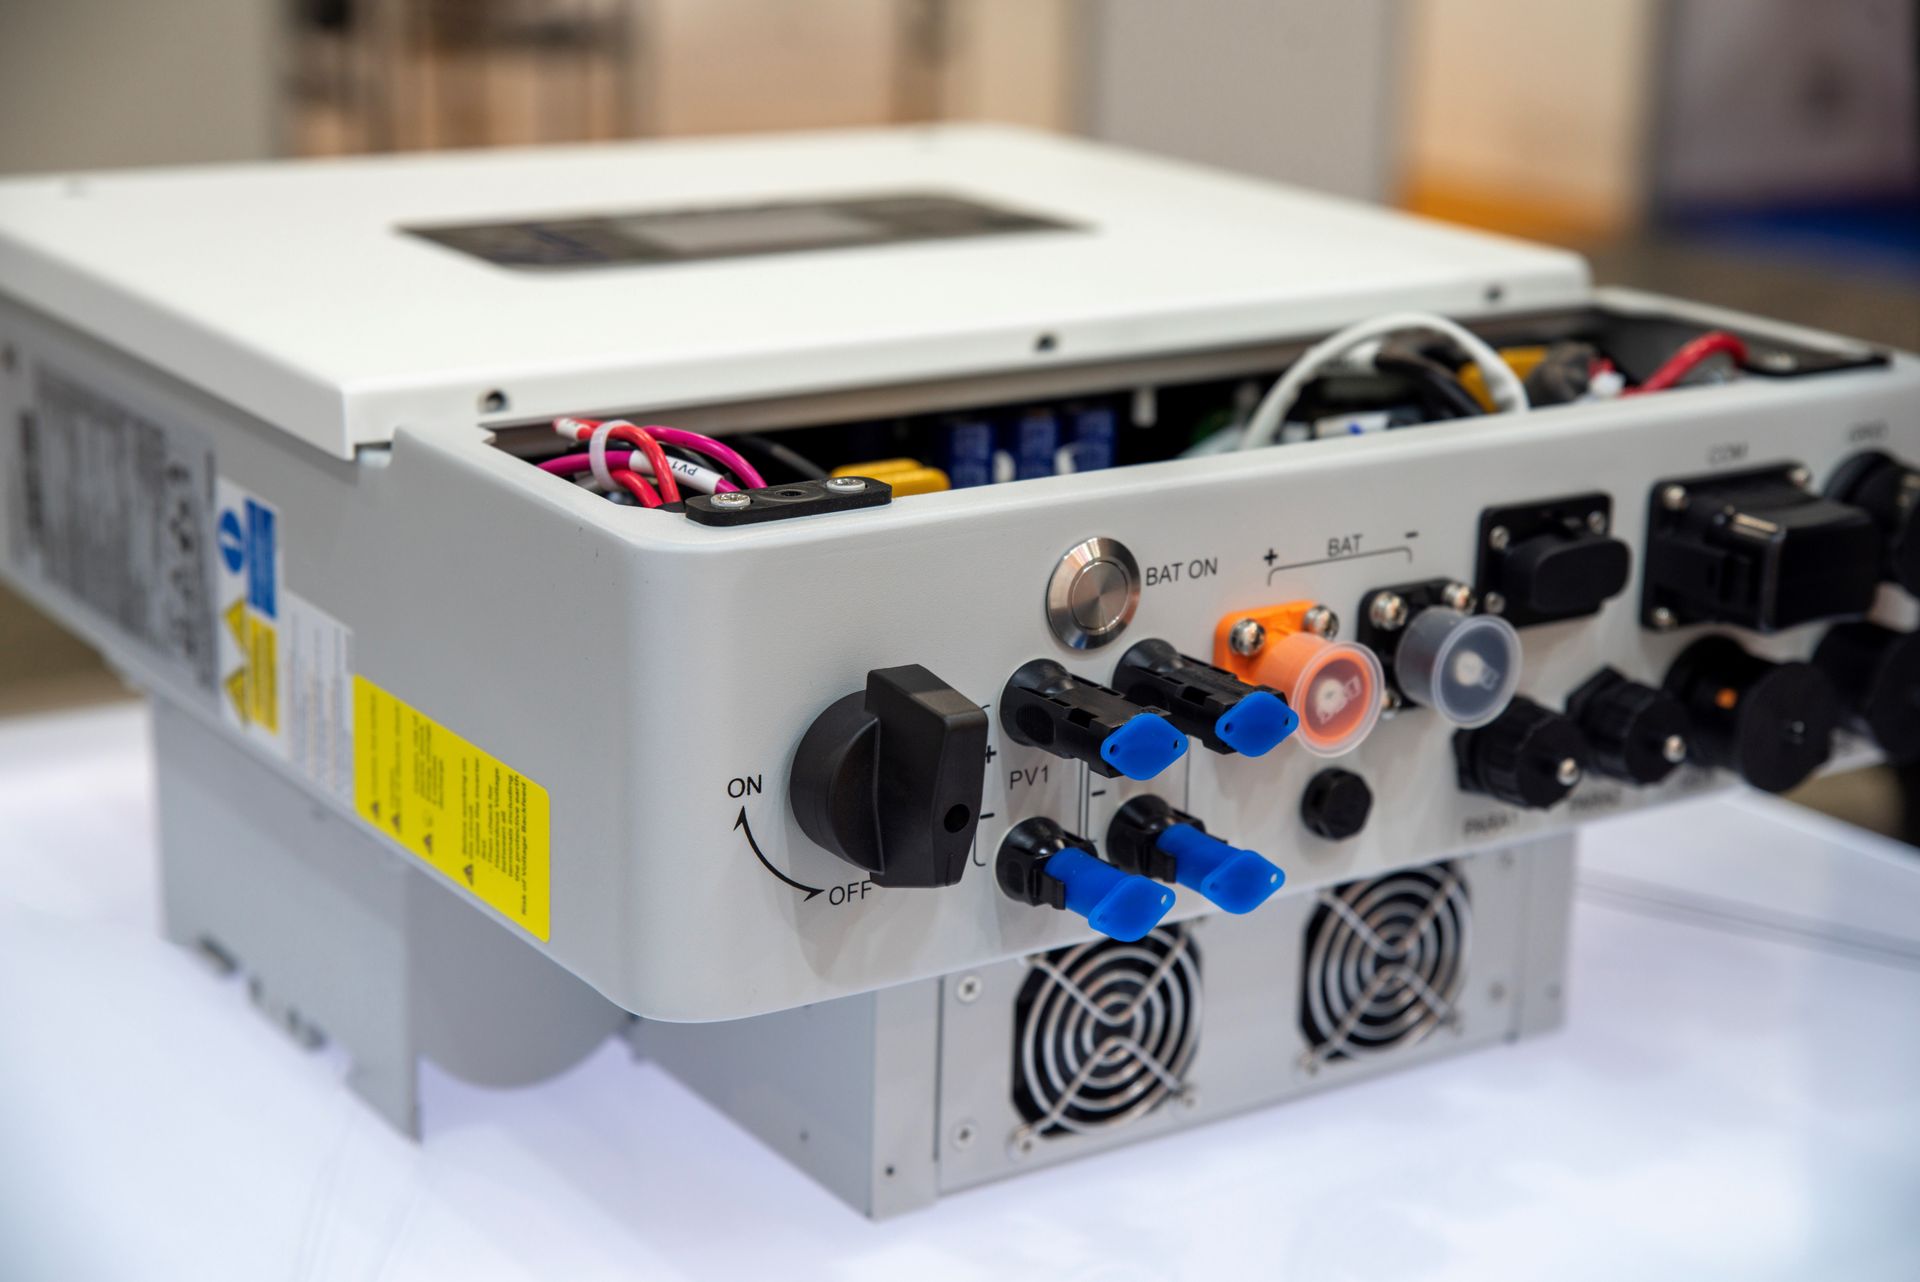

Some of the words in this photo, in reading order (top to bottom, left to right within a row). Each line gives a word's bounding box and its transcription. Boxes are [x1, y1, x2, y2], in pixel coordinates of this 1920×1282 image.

[672, 460, 698, 476] PV1
[1328, 534, 1363, 557] BAT
[1145, 562, 1183, 586] BAT
[1188, 557, 1218, 579] ON
[727, 774, 762, 798] ON
[1010, 765, 1048, 790] PV1
[829, 879, 872, 905] OFF
